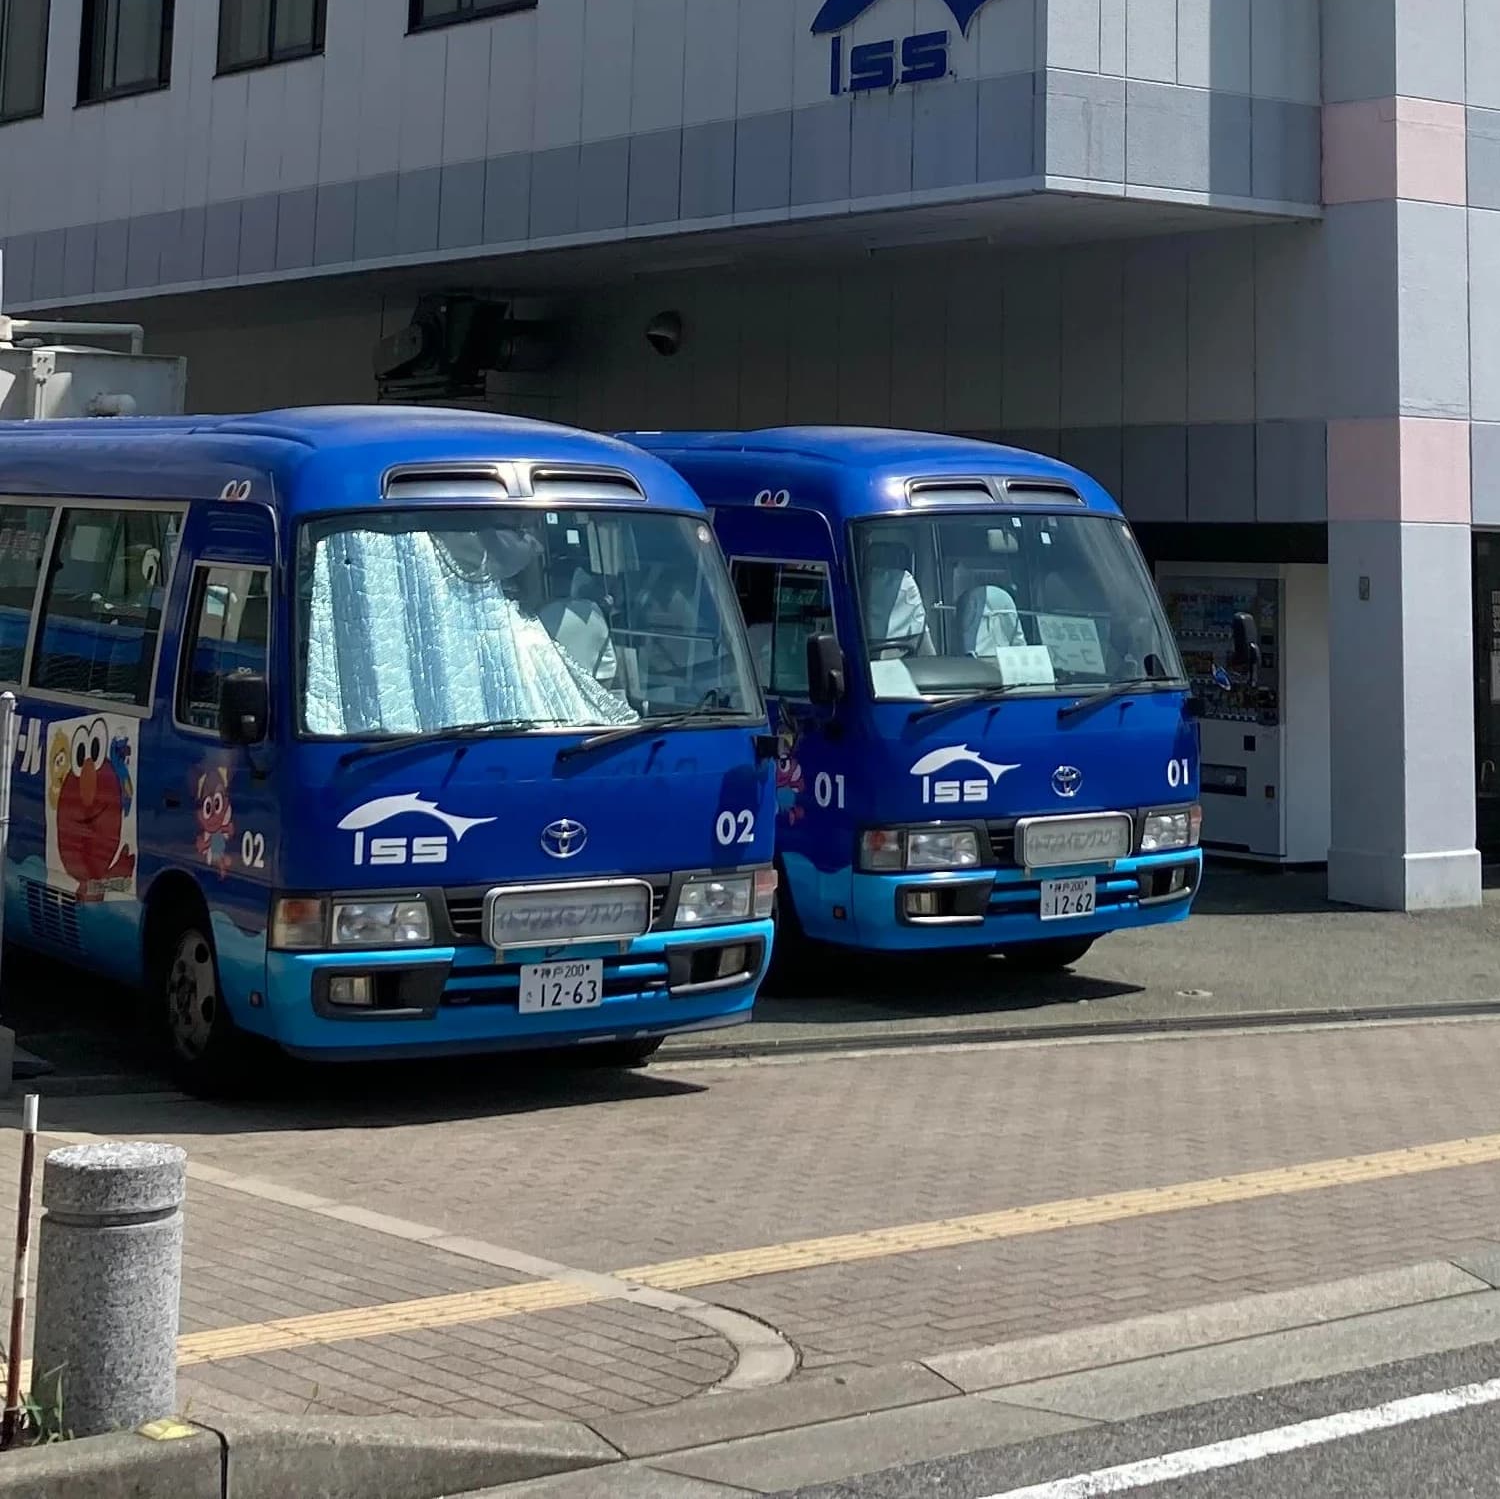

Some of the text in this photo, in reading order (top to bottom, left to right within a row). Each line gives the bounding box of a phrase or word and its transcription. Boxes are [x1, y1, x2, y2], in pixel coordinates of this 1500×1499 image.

[1167, 758, 1189, 787] 01
[814, 771, 845, 808] 01
[922, 776, 989, 804] ISS
[716, 810, 755, 845] 02
[241, 831, 265, 869] 02
[354, 831, 448, 866] ISS
[1054, 893, 1092, 915] 12-62
[541, 980, 597, 1008] 12-63
